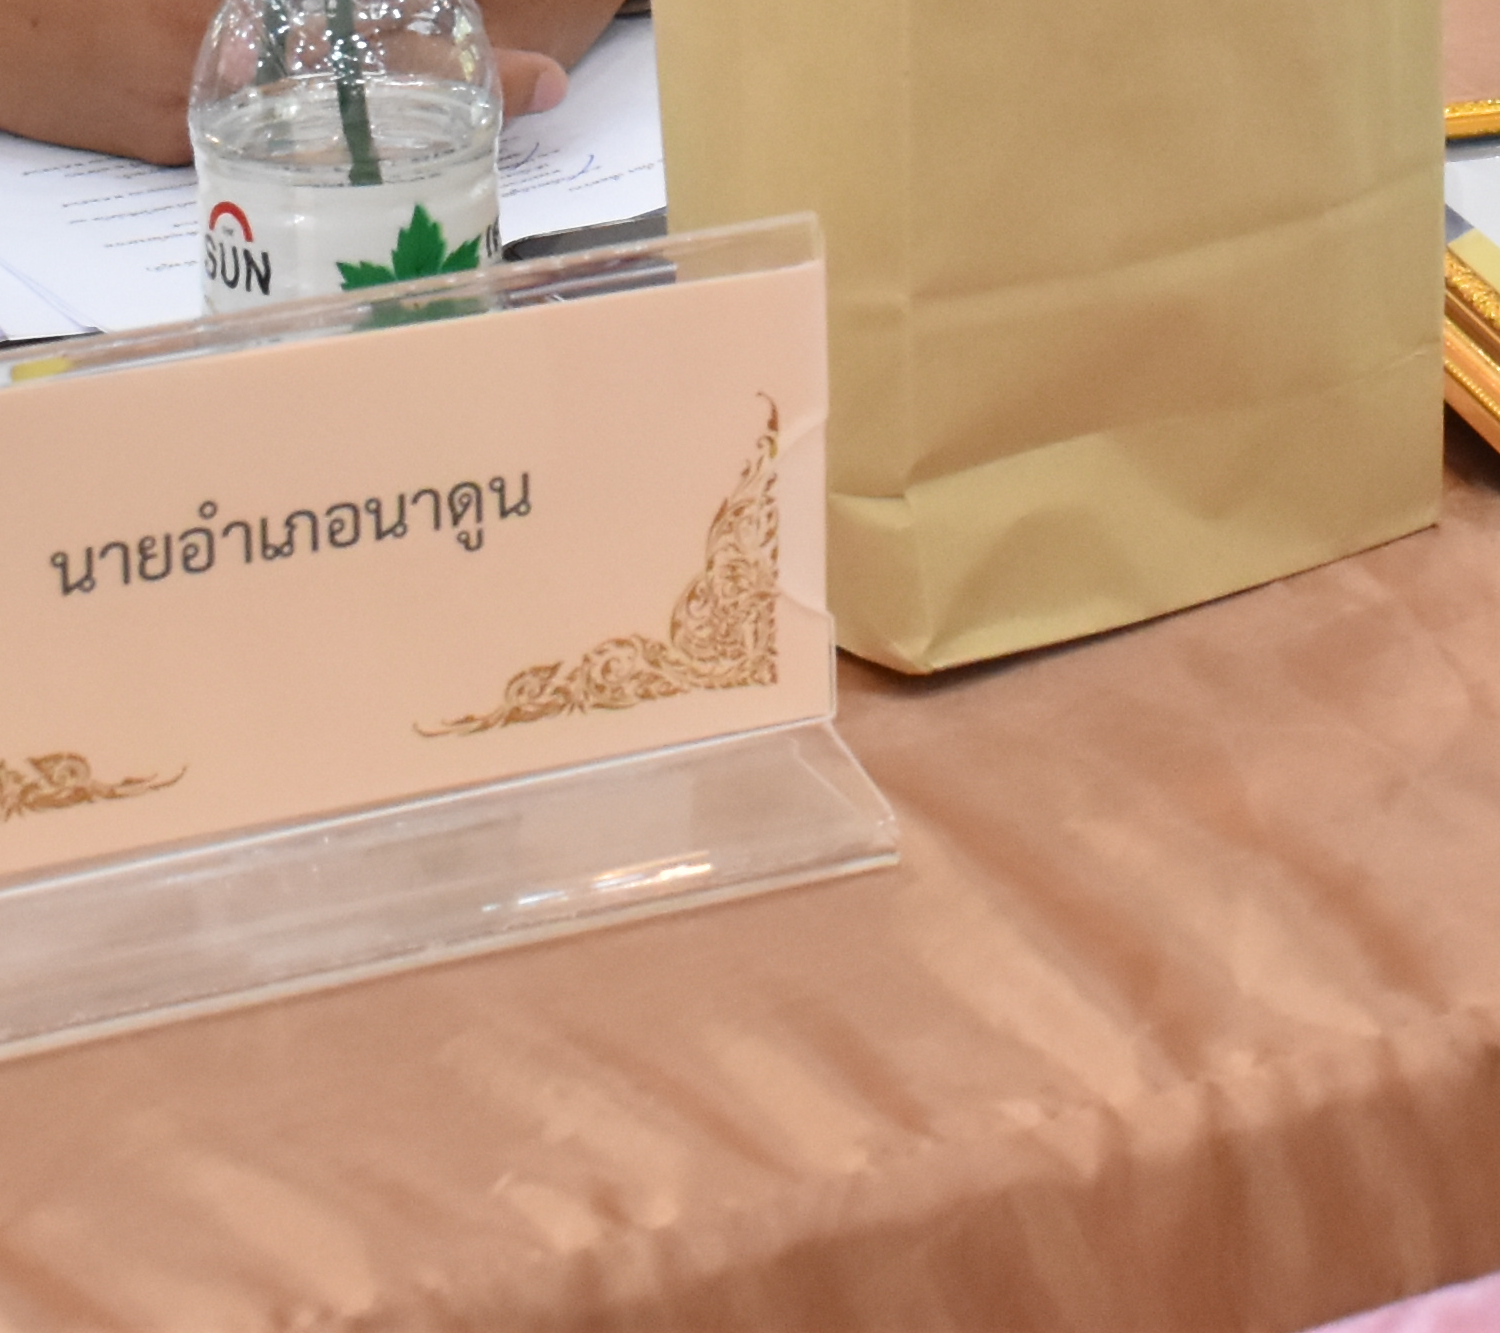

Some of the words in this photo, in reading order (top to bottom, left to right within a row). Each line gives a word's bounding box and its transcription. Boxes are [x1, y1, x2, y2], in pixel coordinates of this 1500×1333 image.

[204, 233, 272, 296] SUN
[50, 473, 531, 596] นายอำเภอนาดูน
